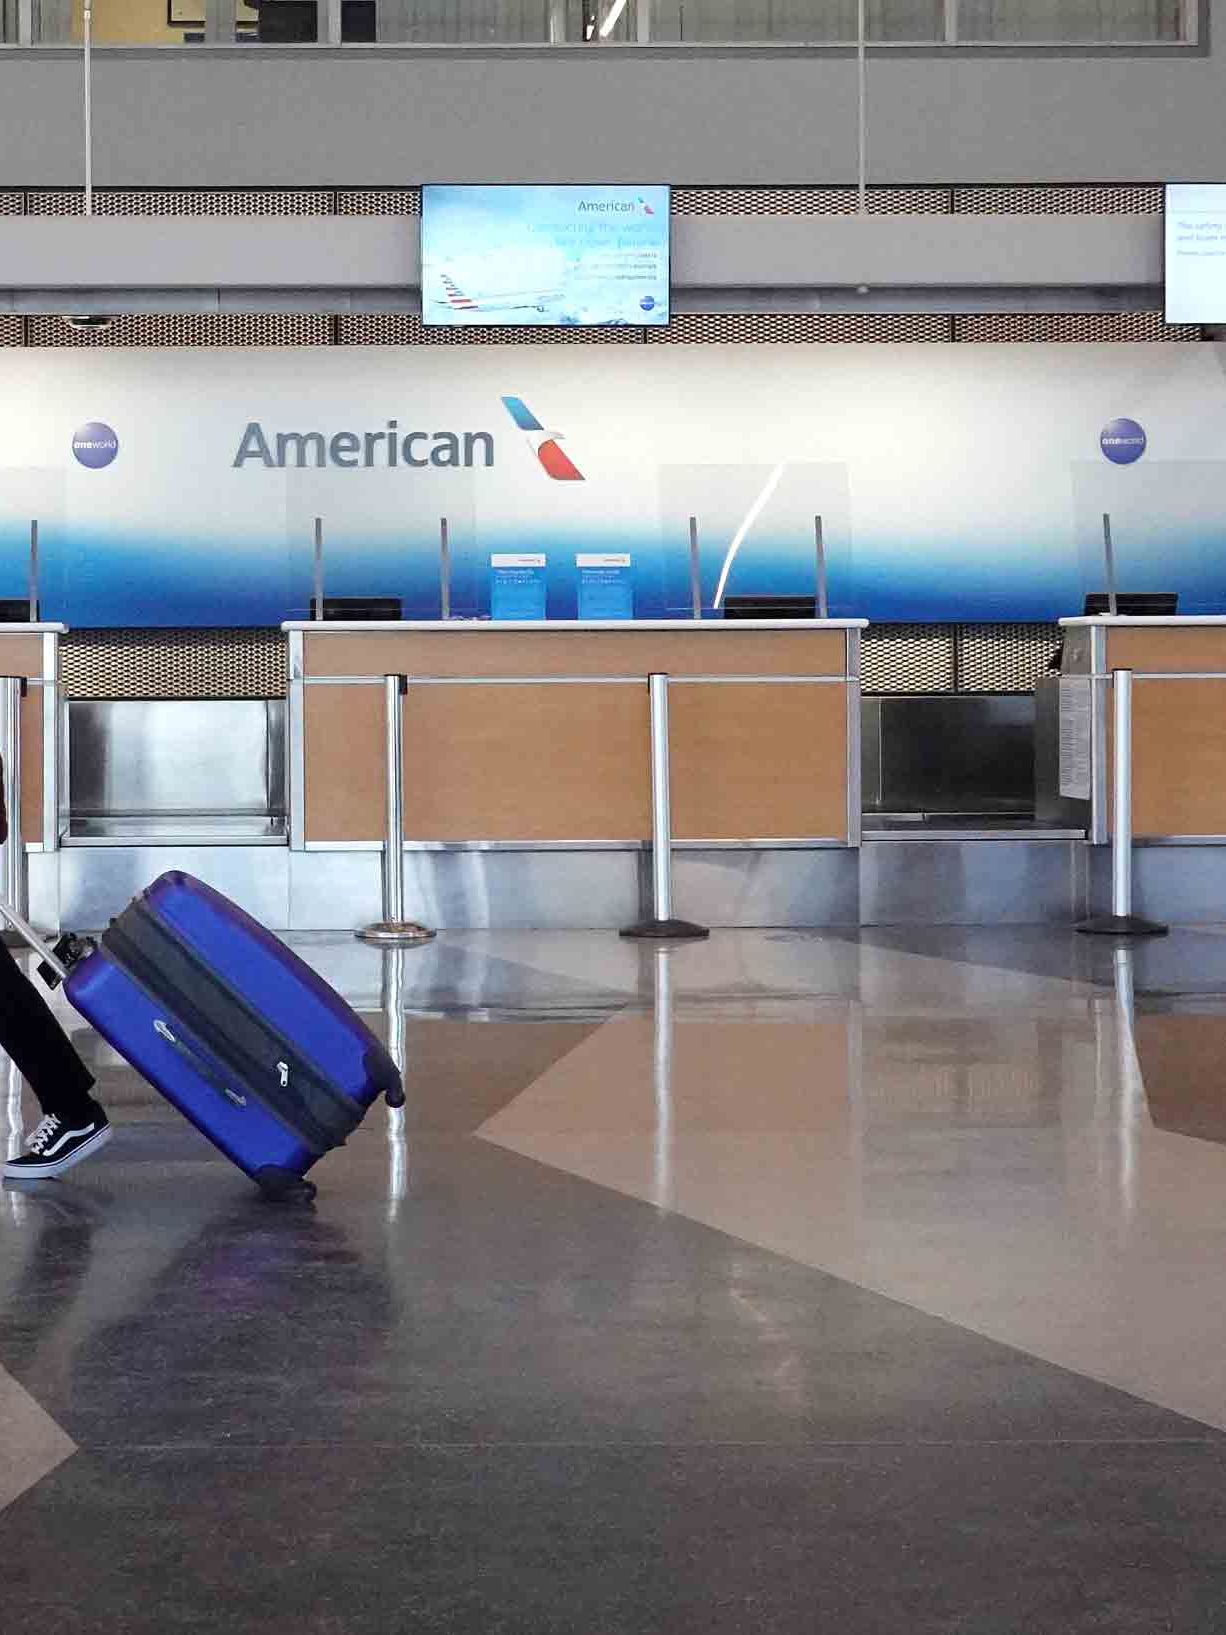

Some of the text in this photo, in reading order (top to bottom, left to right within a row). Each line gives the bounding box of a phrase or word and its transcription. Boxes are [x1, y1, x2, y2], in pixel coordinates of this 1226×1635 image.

[577, 200, 635, 212] American
[73, 440, 117, 449] oneworld
[232, 420, 495, 468] American
